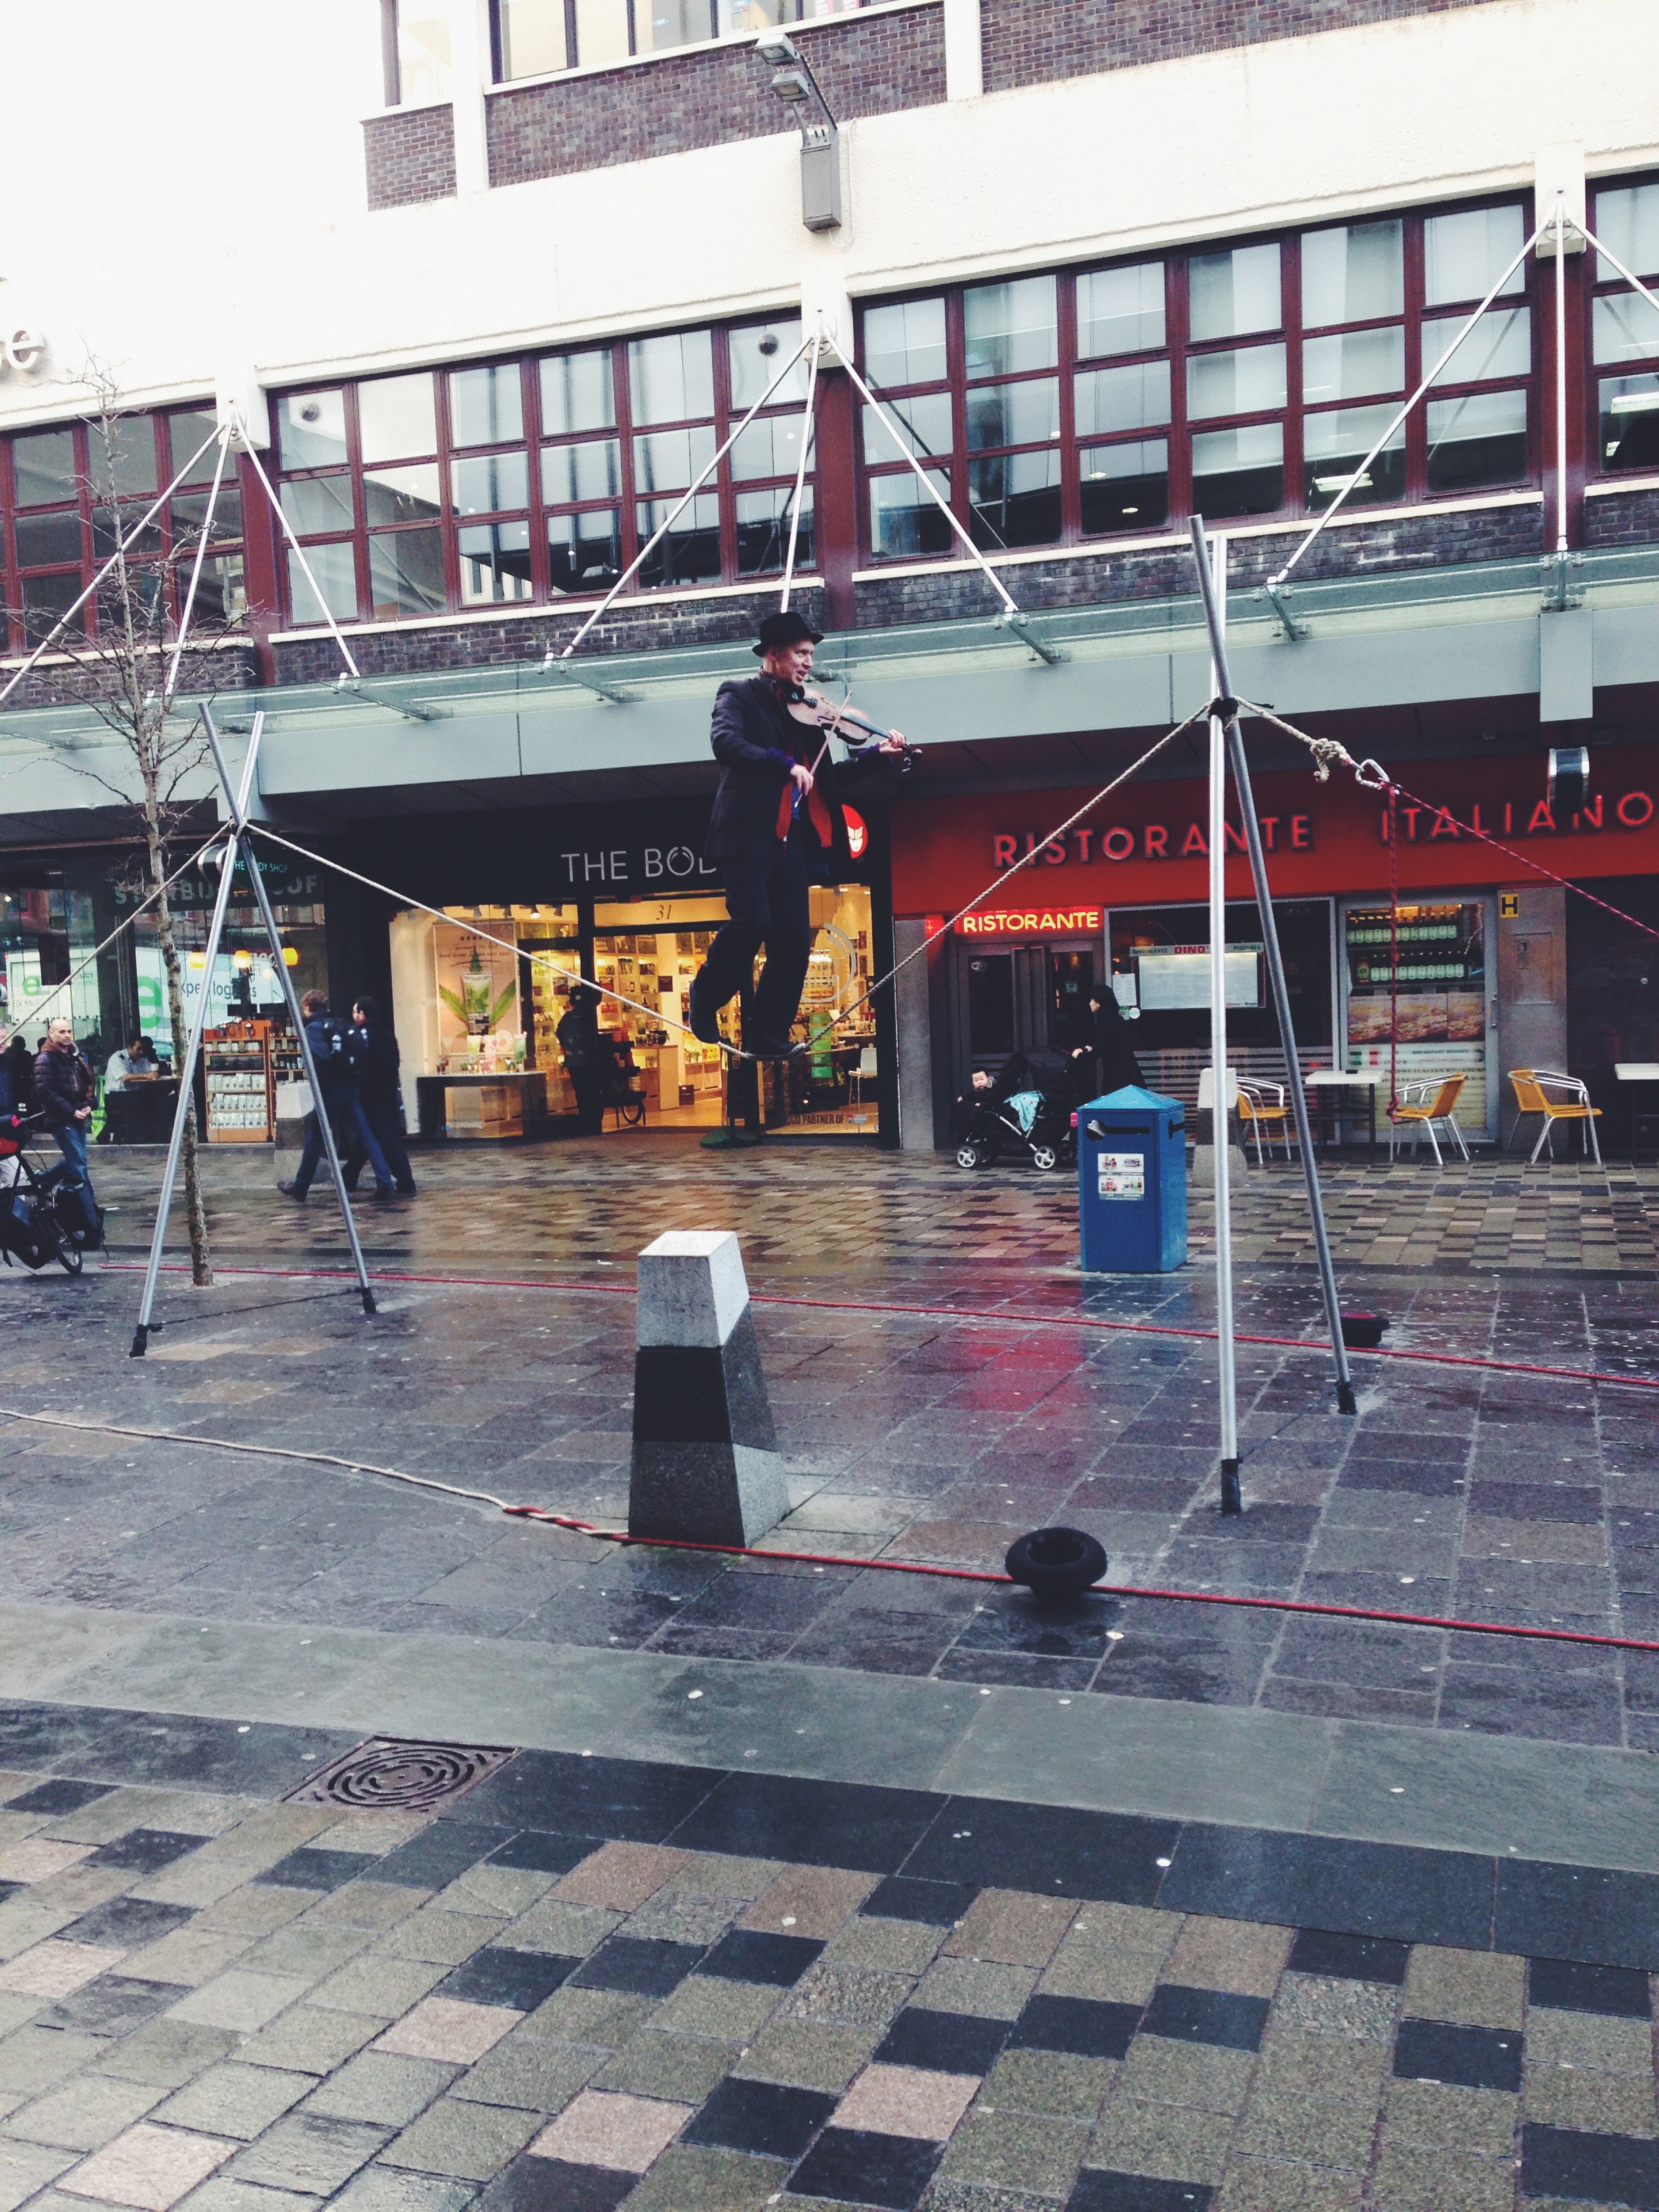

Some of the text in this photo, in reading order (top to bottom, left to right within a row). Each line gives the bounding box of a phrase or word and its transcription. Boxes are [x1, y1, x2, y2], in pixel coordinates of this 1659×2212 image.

[994, 790, 1654, 867] RISTORANTE ITALIANO
[234, 860, 245, 871] HE
[270, 863, 288, 873] SHOP
[560, 851, 628, 882] THE
[656, 904, 672, 921] 31
[963, 912, 1099, 933] RISTORANTE
[802, 1114, 834, 1125] PARTNER
[836, 1113, 844, 1124] OF
